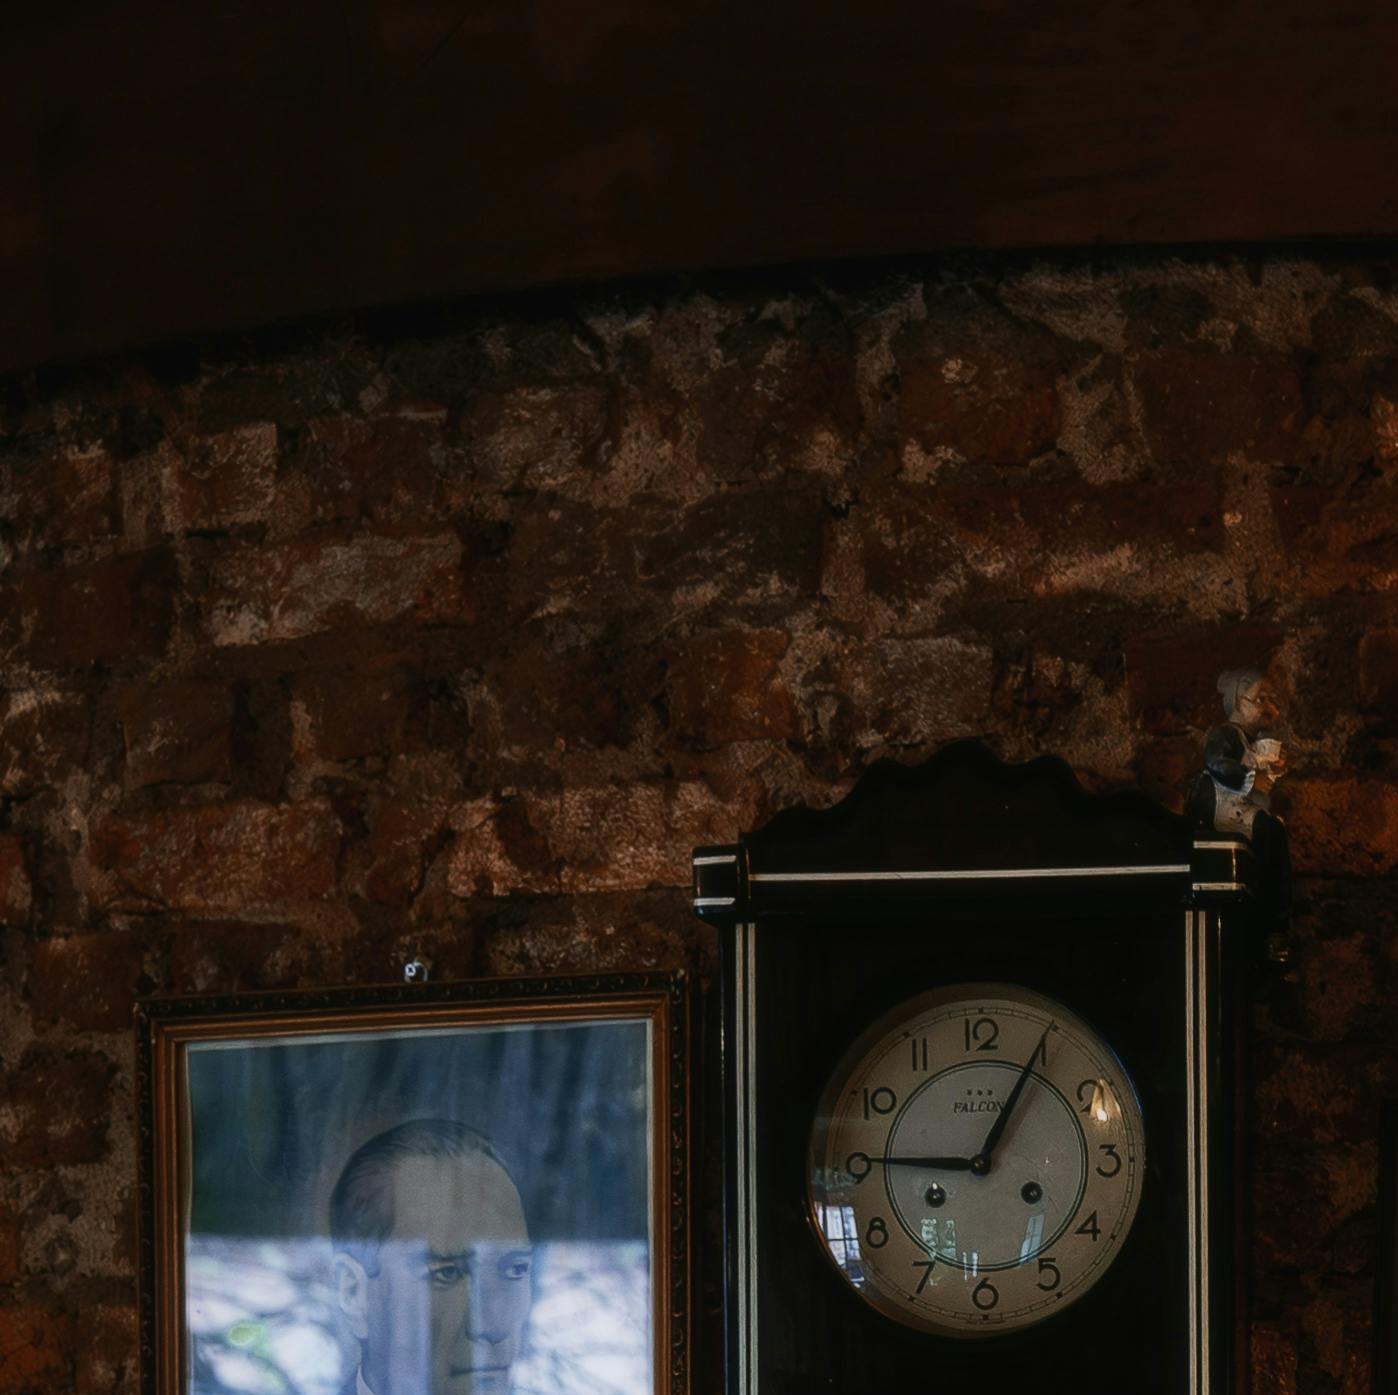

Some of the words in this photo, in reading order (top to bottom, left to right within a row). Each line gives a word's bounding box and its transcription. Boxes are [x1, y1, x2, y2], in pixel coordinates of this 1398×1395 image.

[964, 1018, 999, 1052] 12
[912, 1039, 928, 1071] 11
[863, 1086, 897, 1120] 10
[846, 1152, 872, 1185] 9
[1096, 1144, 1122, 1178] 3
[866, 1217, 889, 1248] 8
[1075, 1210, 1101, 1242] 4
[912, 1261, 936, 1294] 7
[1036, 1257, 1061, 1291] 5
[972, 1277, 999, 1310] 6
